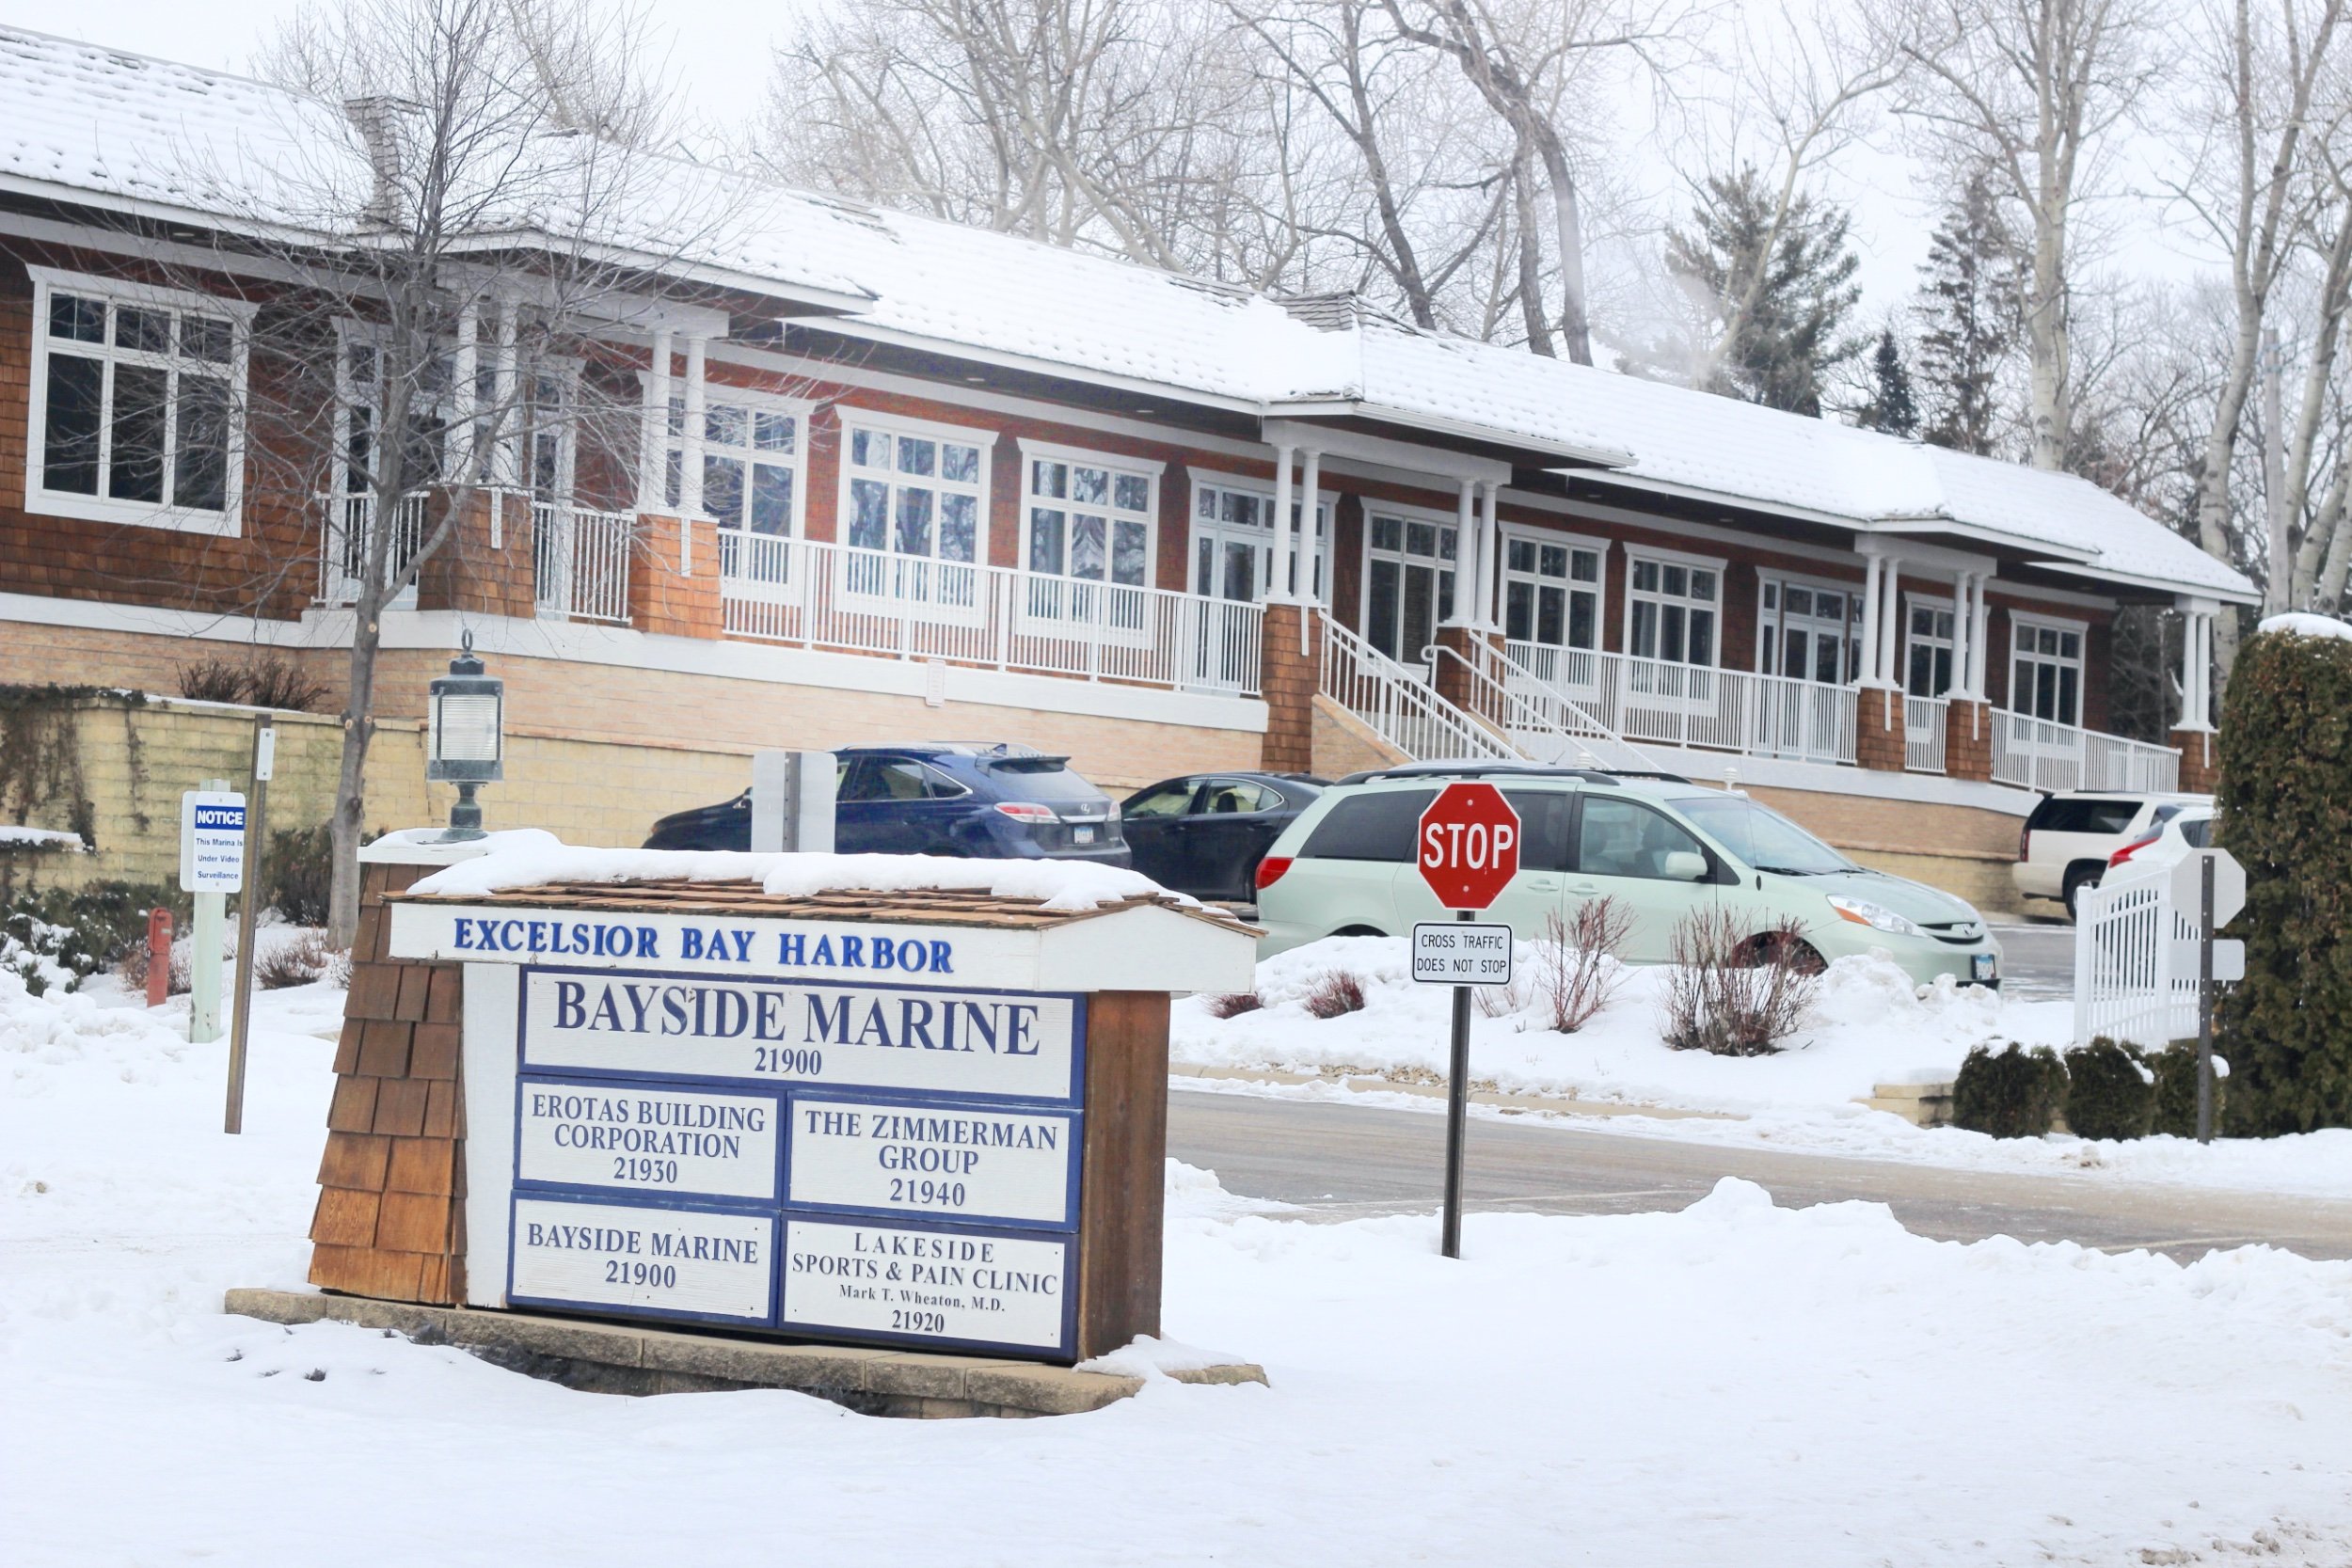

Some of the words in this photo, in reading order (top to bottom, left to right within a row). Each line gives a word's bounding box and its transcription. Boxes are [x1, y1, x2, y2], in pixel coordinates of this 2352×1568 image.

[197, 810, 244, 825] NOTICE
[213, 838, 235, 847] Marina
[1423, 823, 1514, 869] STOP
[198, 871, 239, 879] Surveillance
[453, 918, 660, 958] EXCELSIOR
[681, 927, 755, 961] BAY
[778, 932, 954, 973] HARBOR
[1422, 934, 1455, 948] CROSS
[1463, 935, 1503, 949] TRAFFIC
[1417, 958, 1445, 972] DOES
[1453, 958, 1473, 973] NOT
[1481, 959, 1506, 974] STOP
[553, 980, 785, 1041] BAYSIDE
[803, 993, 1040, 1056] MARINE
[754, 1046, 822, 1076] 21900
[532, 1094, 628, 1123] EROTAS
[638, 1101, 765, 1132] BUILDING
[554, 1124, 740, 1159] CORPORATION
[805, 1110, 862, 1137] THE
[871, 1115, 1057, 1150] ZIMMERMAN
[613, 1156, 677, 1183] 21930
[879, 1145, 978, 1175] GROUP
[889, 1178, 965, 1207] 21940
[527, 1223, 642, 1255] BAYSIDE
[651, 1232, 758, 1264] MARINE
[854, 1232, 994, 1263] LAKESIDE
[605, 1259, 676, 1289] 21900
[792, 1252, 878, 1279] SPORTS
[885, 1260, 902, 1281] &
[911, 1263, 964, 1286] PAIN
[973, 1268, 1058, 1295] CLINIC
[839, 1284, 876, 1301] Mark
[882, 1288, 895, 1303] T.
[900, 1290, 966, 1310] Wheaton,
[971, 1295, 1006, 1312] M.D.
[892, 1309, 946, 1333] 21920
